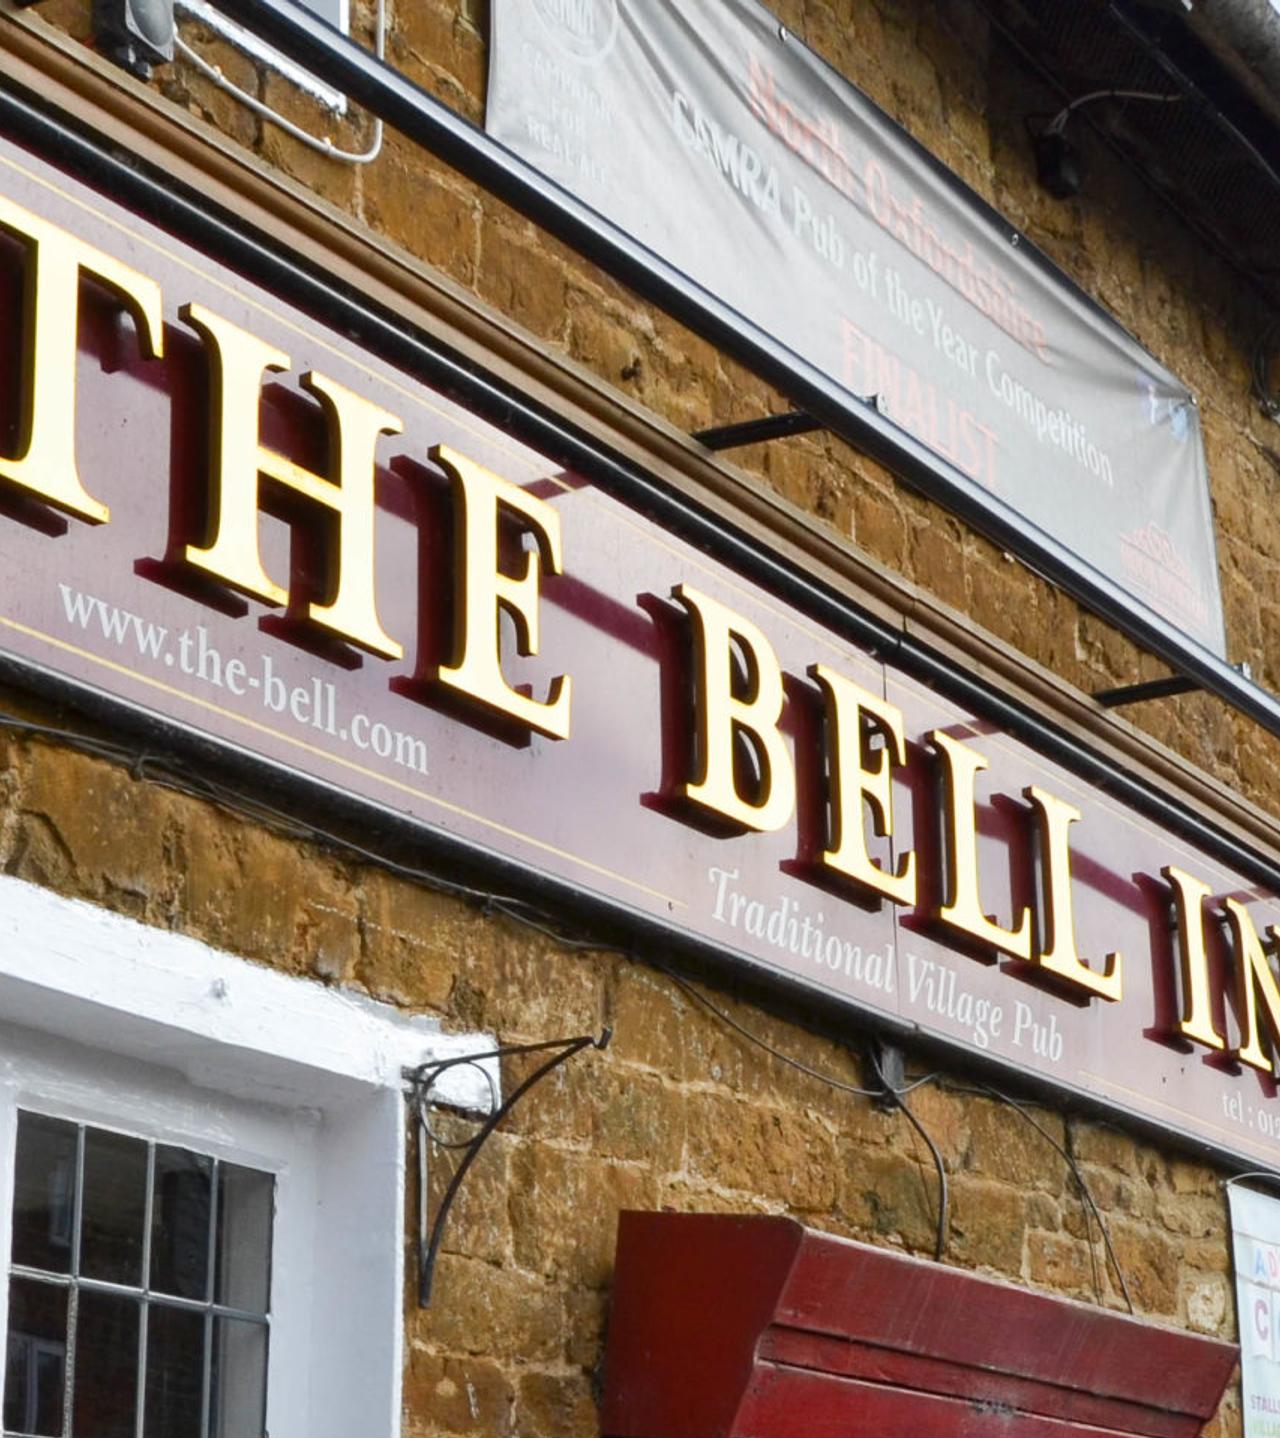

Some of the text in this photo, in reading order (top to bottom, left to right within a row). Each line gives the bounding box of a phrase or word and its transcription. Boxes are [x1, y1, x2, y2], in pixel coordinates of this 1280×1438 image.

[671, 91, 1115, 489] CAMRA Pub of the Year Competition
[748, 56, 1051, 368] North Oxfordshire
[839, 314, 999, 490] FINALIST
[58, 582, 430, 776] www.the-bell.com
[672, 582, 1123, 1004] BELL
[707, 866, 1064, 1063] Traditional Village Pub
